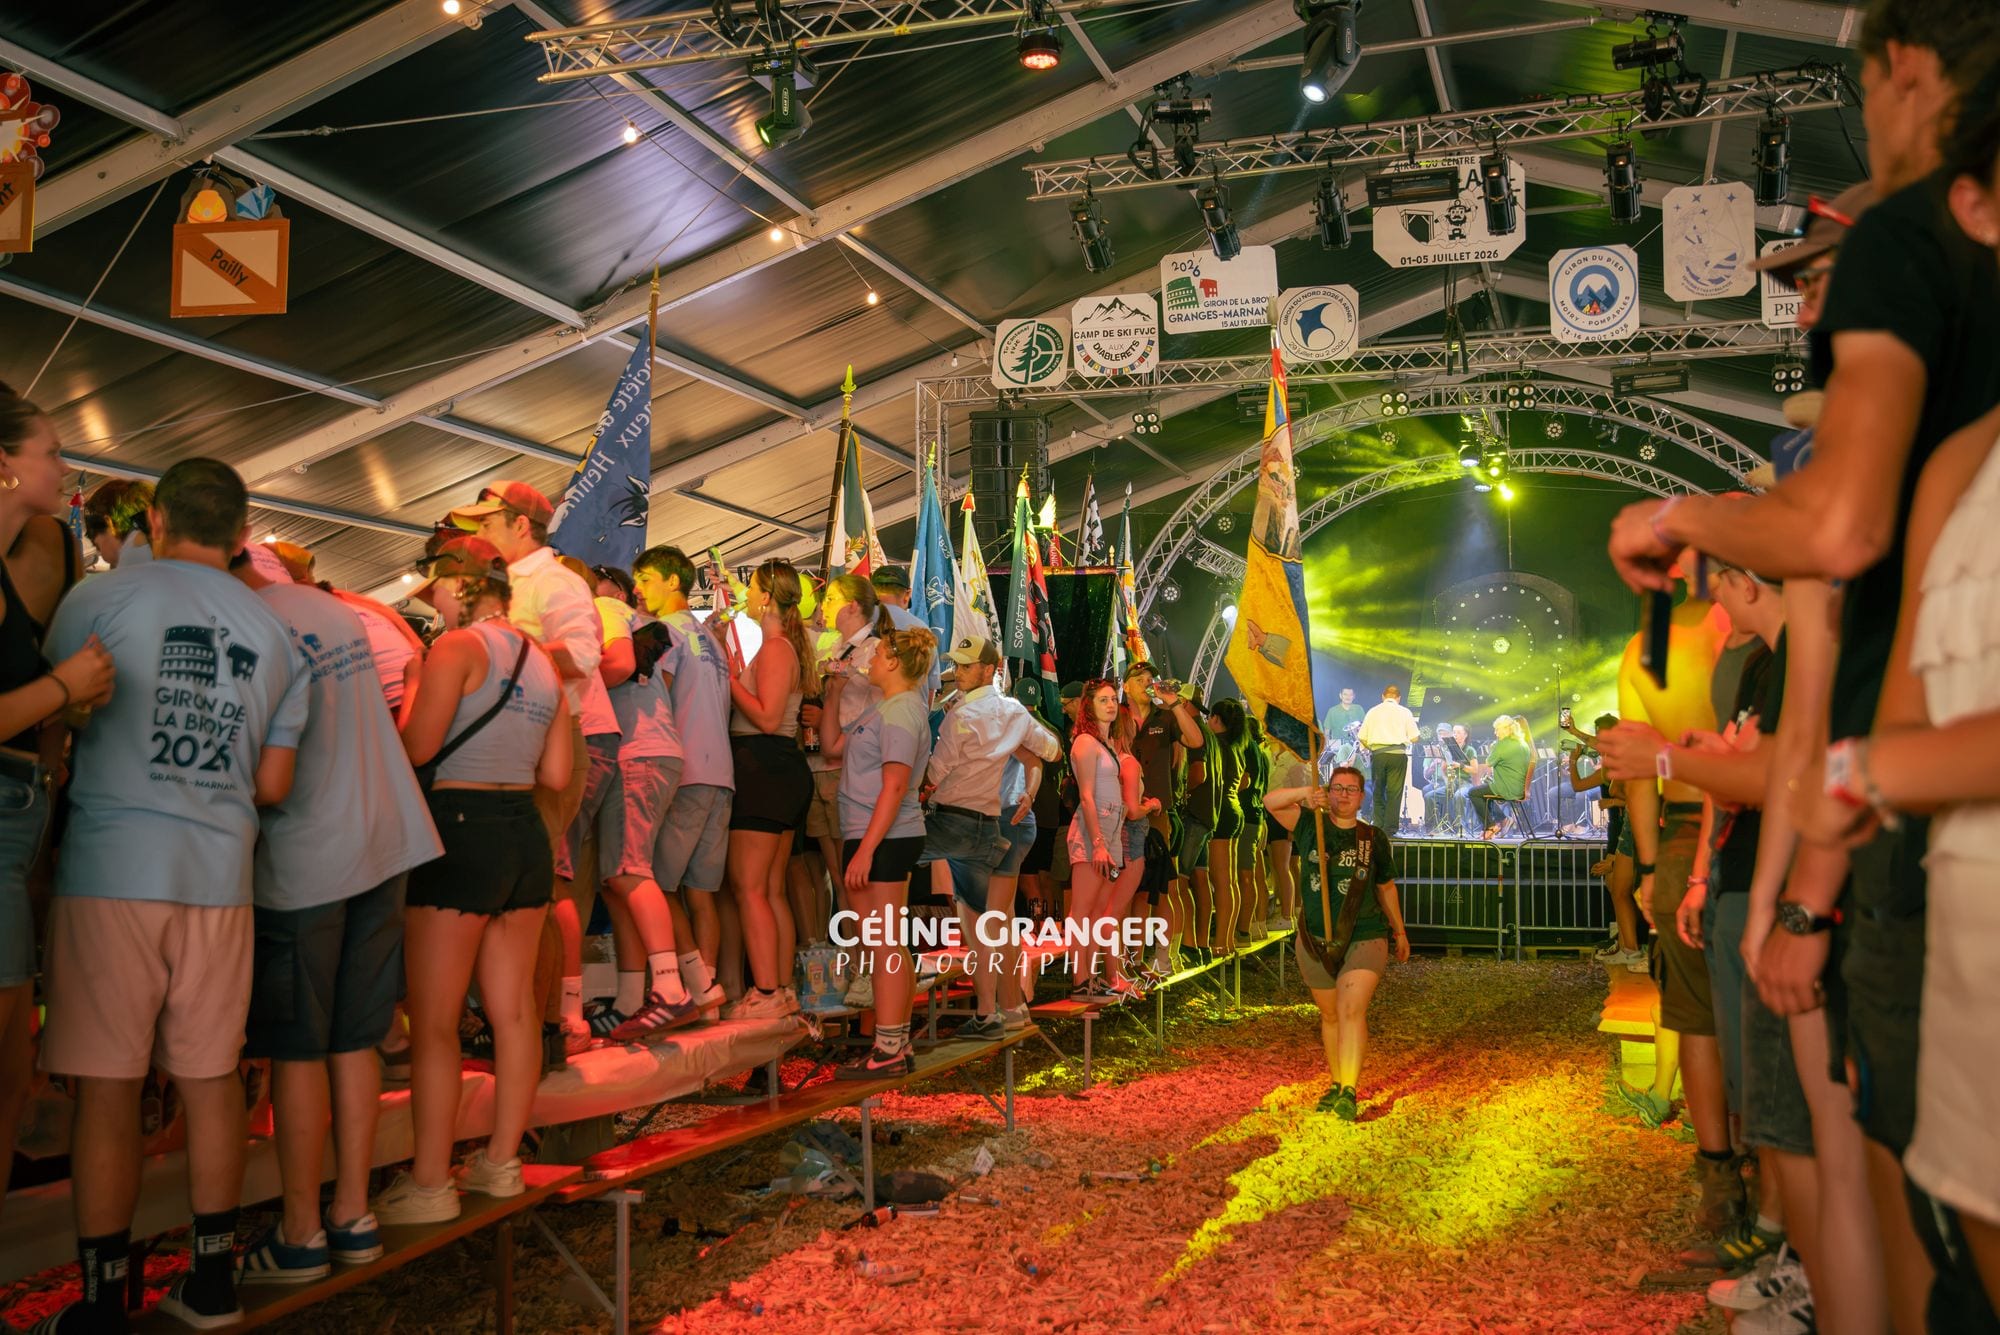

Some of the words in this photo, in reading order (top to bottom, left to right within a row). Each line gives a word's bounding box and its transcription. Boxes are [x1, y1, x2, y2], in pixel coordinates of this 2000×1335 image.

[211, 249, 248, 286] Pailly
[1401, 255, 1429, 265] 01-05
[1432, 252, 1471, 263] JUILLET
[1474, 250, 1499, 260] 2026
[1565, 256, 1588, 276] GIRON
[1204, 300, 1228, 308] GIRON
[1343, 303, 1353, 323] ARNEX
[1560, 300, 1580, 321] MOIRY
[1588, 296, 1630, 326] POMPAPLES
[1168, 307, 1268, 323] GRANGES-MARNAN
[1074, 330, 1100, 339] CAMP
[1103, 330, 1115, 338] DE
[1117, 328, 1132, 337] SKI
[1134, 327, 1156, 336] FVJC
[1093, 340, 1140, 361] DIABLERETS
[156, 686, 218, 714] GIRON
[220, 702, 246, 723] DE
[153, 708, 178, 728] LA
[185, 713, 241, 742] BROYE
